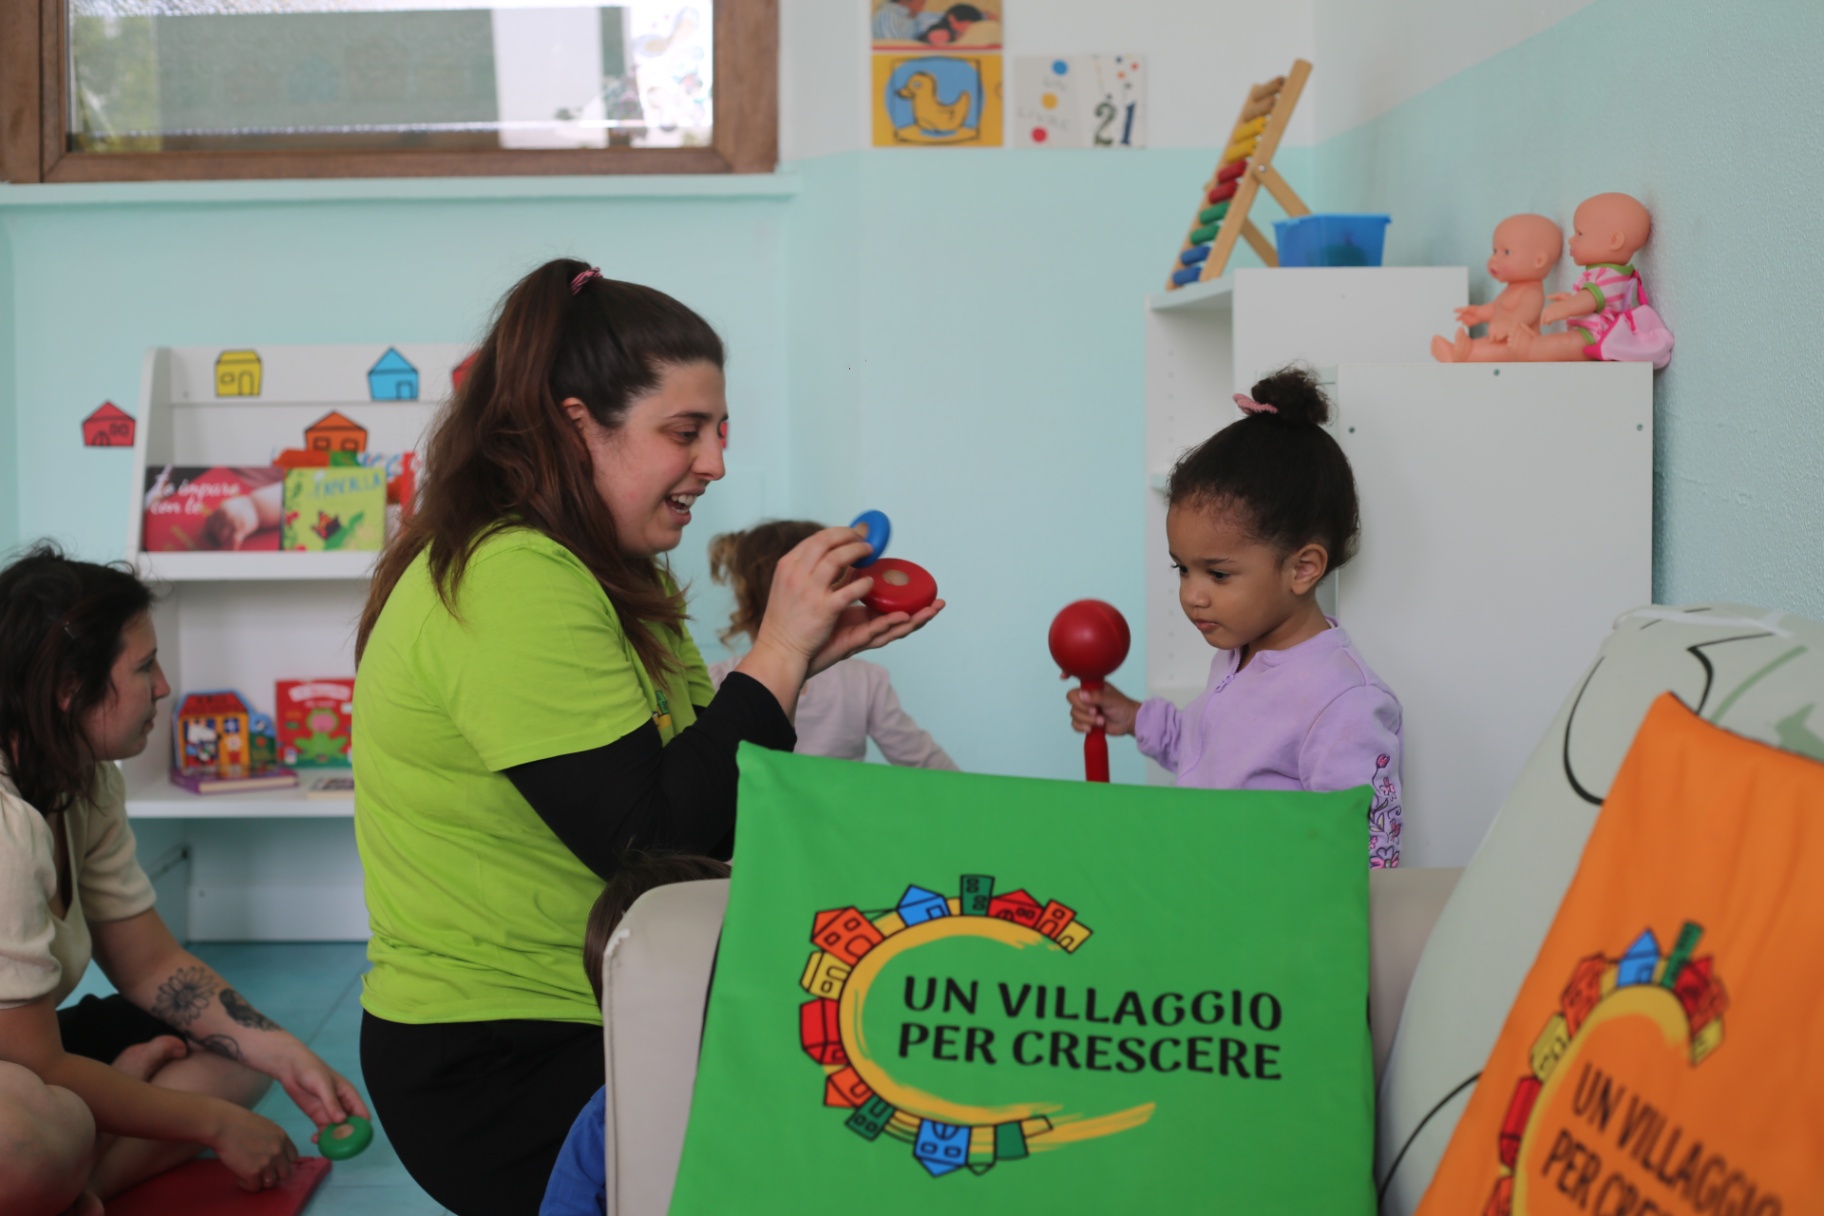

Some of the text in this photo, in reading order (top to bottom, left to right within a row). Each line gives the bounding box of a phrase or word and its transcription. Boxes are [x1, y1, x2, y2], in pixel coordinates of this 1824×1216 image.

[902, 974, 1283, 1033] UN VILLAGGIO
[897, 1021, 1283, 1081] PER CRESCERE
[1571, 1061, 1627, 1135] UN
[1540, 1128, 1602, 1211] PER
